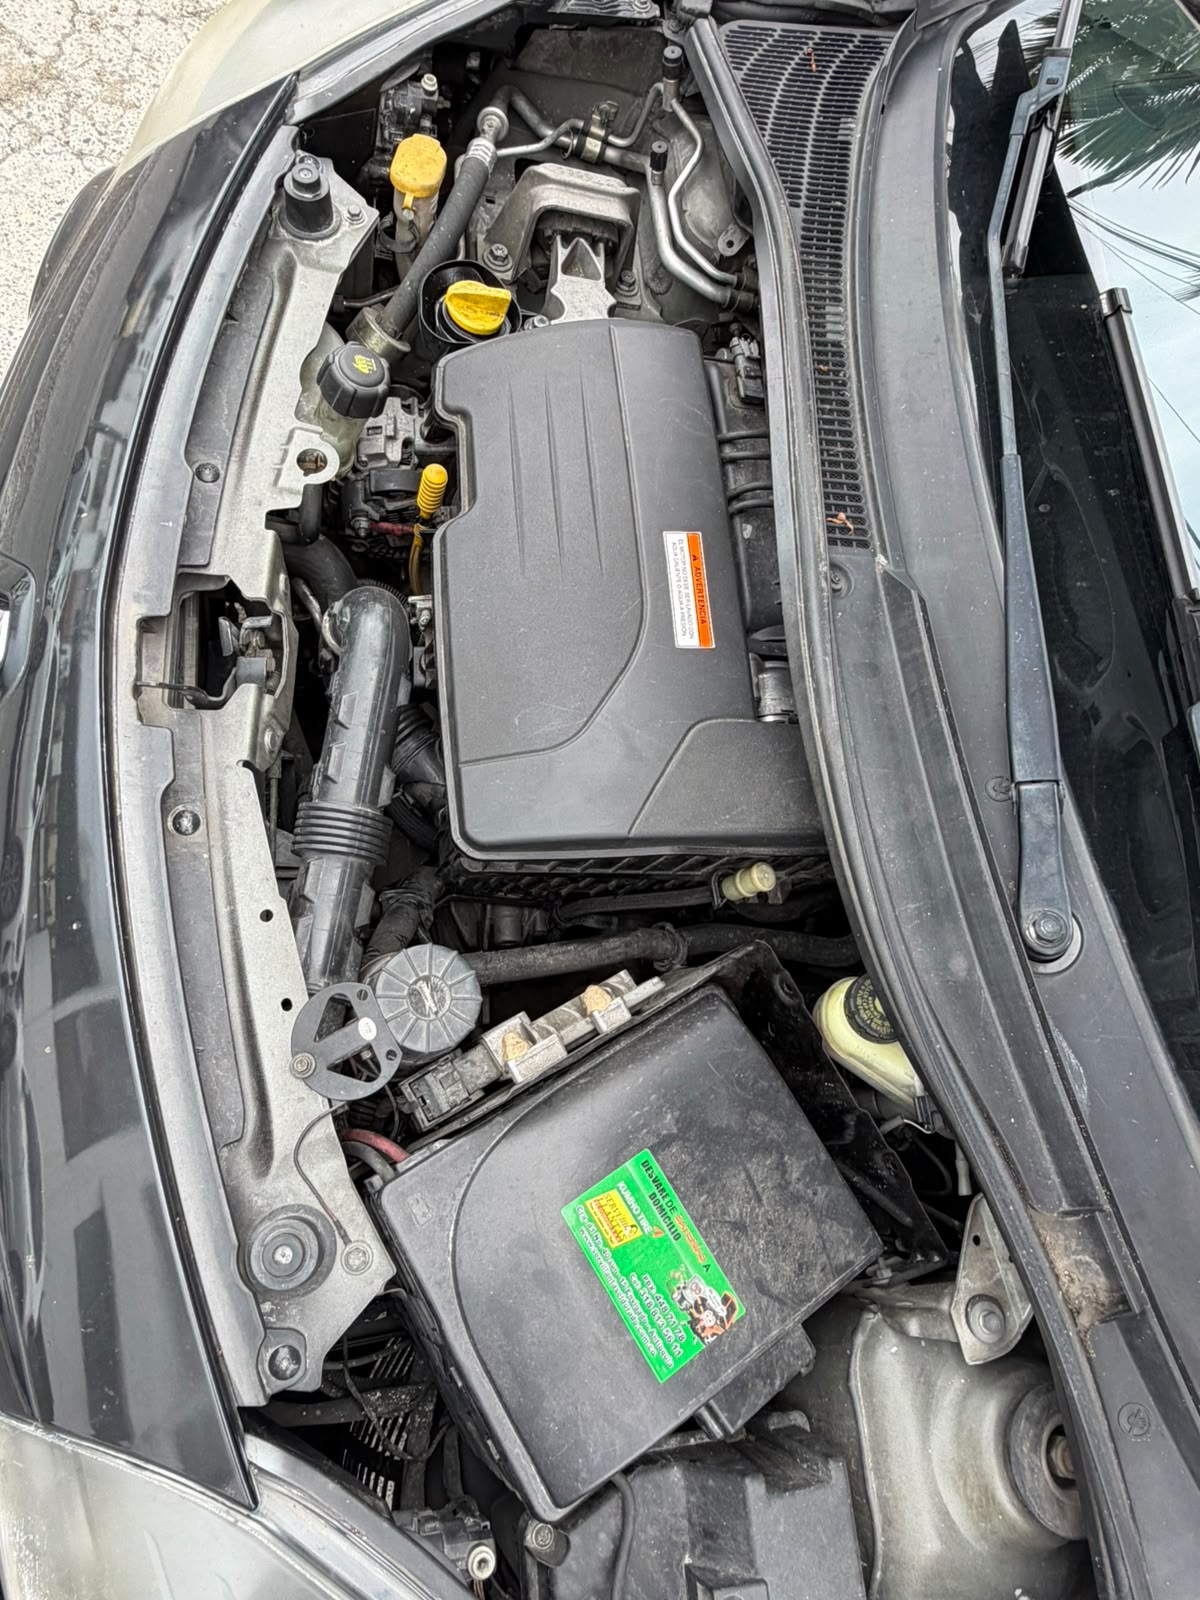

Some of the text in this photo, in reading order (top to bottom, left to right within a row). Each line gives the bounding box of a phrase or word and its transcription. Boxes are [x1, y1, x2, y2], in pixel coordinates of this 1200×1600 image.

[682, 566, 688, 575] NO
[694, 566, 707, 624] ADVERTENCIA
[597, 1198, 625, 1242] LLANTAS
[604, 1193, 622, 1218] SERVI
[617, 1181, 652, 1234] KUMHO TIRE
[641, 1160, 668, 1201] DESVARE
[666, 1200, 677, 1214] DE
[703, 1264, 711, 1272] A
[648, 1192, 681, 1241] DOMICILIO
[625, 1288, 648, 1324] Envigado
[650, 1330, 673, 1368] Antioquia
[641, 1290, 652, 1308] 318
[652, 1309, 665, 1327] 813
[664, 1329, 673, 1342] 56
[672, 1344, 682, 1356] 11
[656, 1295, 668, 1312] 448
[666, 1313, 676, 1327] 71
[676, 1328, 685, 1341] 78
